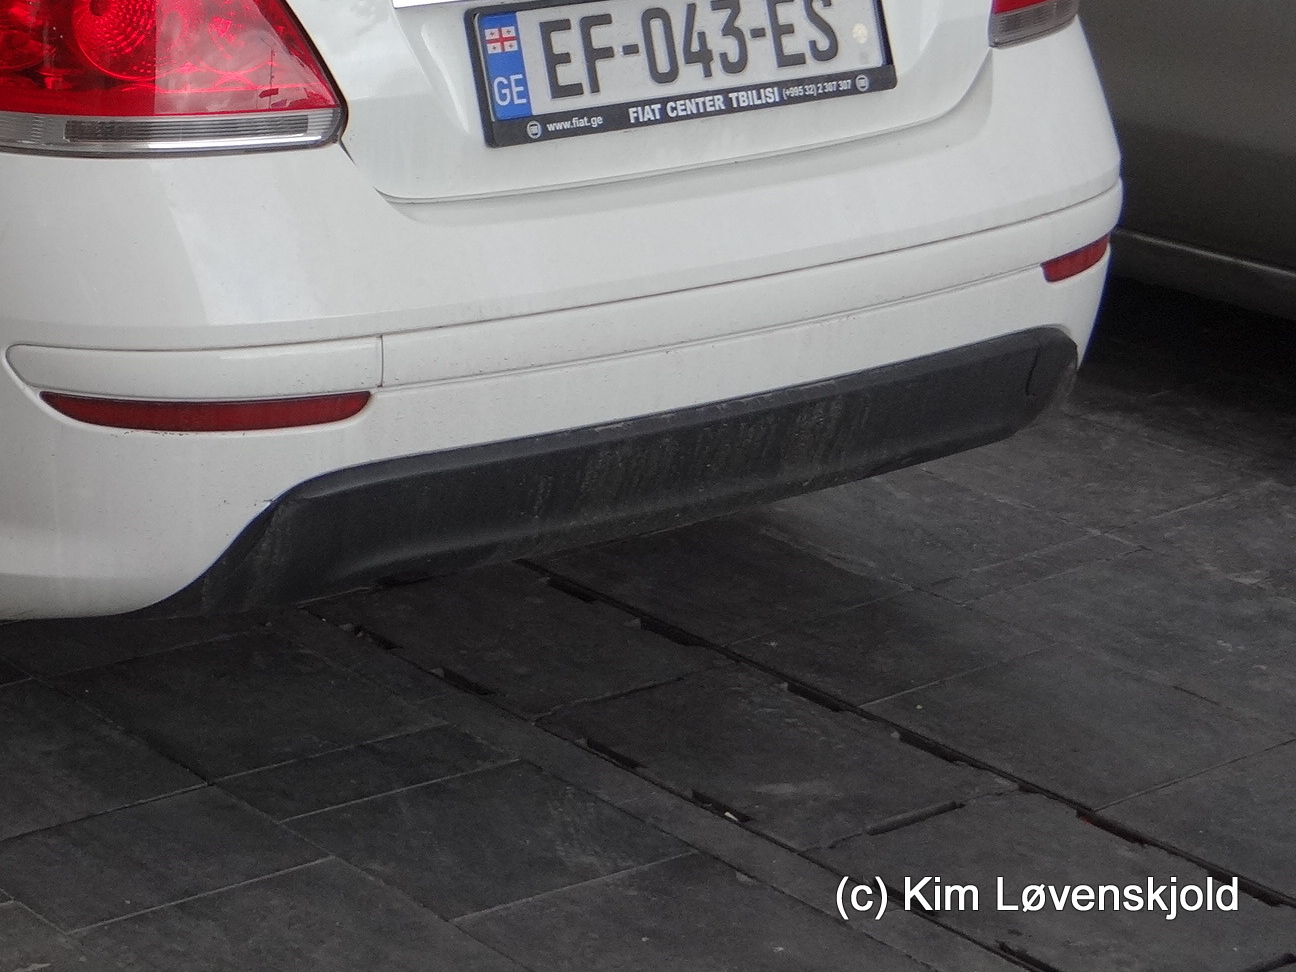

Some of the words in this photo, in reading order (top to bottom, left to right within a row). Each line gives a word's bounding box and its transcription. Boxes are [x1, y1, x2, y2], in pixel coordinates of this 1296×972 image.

[493, 74, 527, 106] GE
[628, 103, 662, 124] FIAT
[666, 94, 725, 118] CENTER
[729, 86, 779, 109] TBILISI
[546, 115, 604, 132] www.fiat.ge
